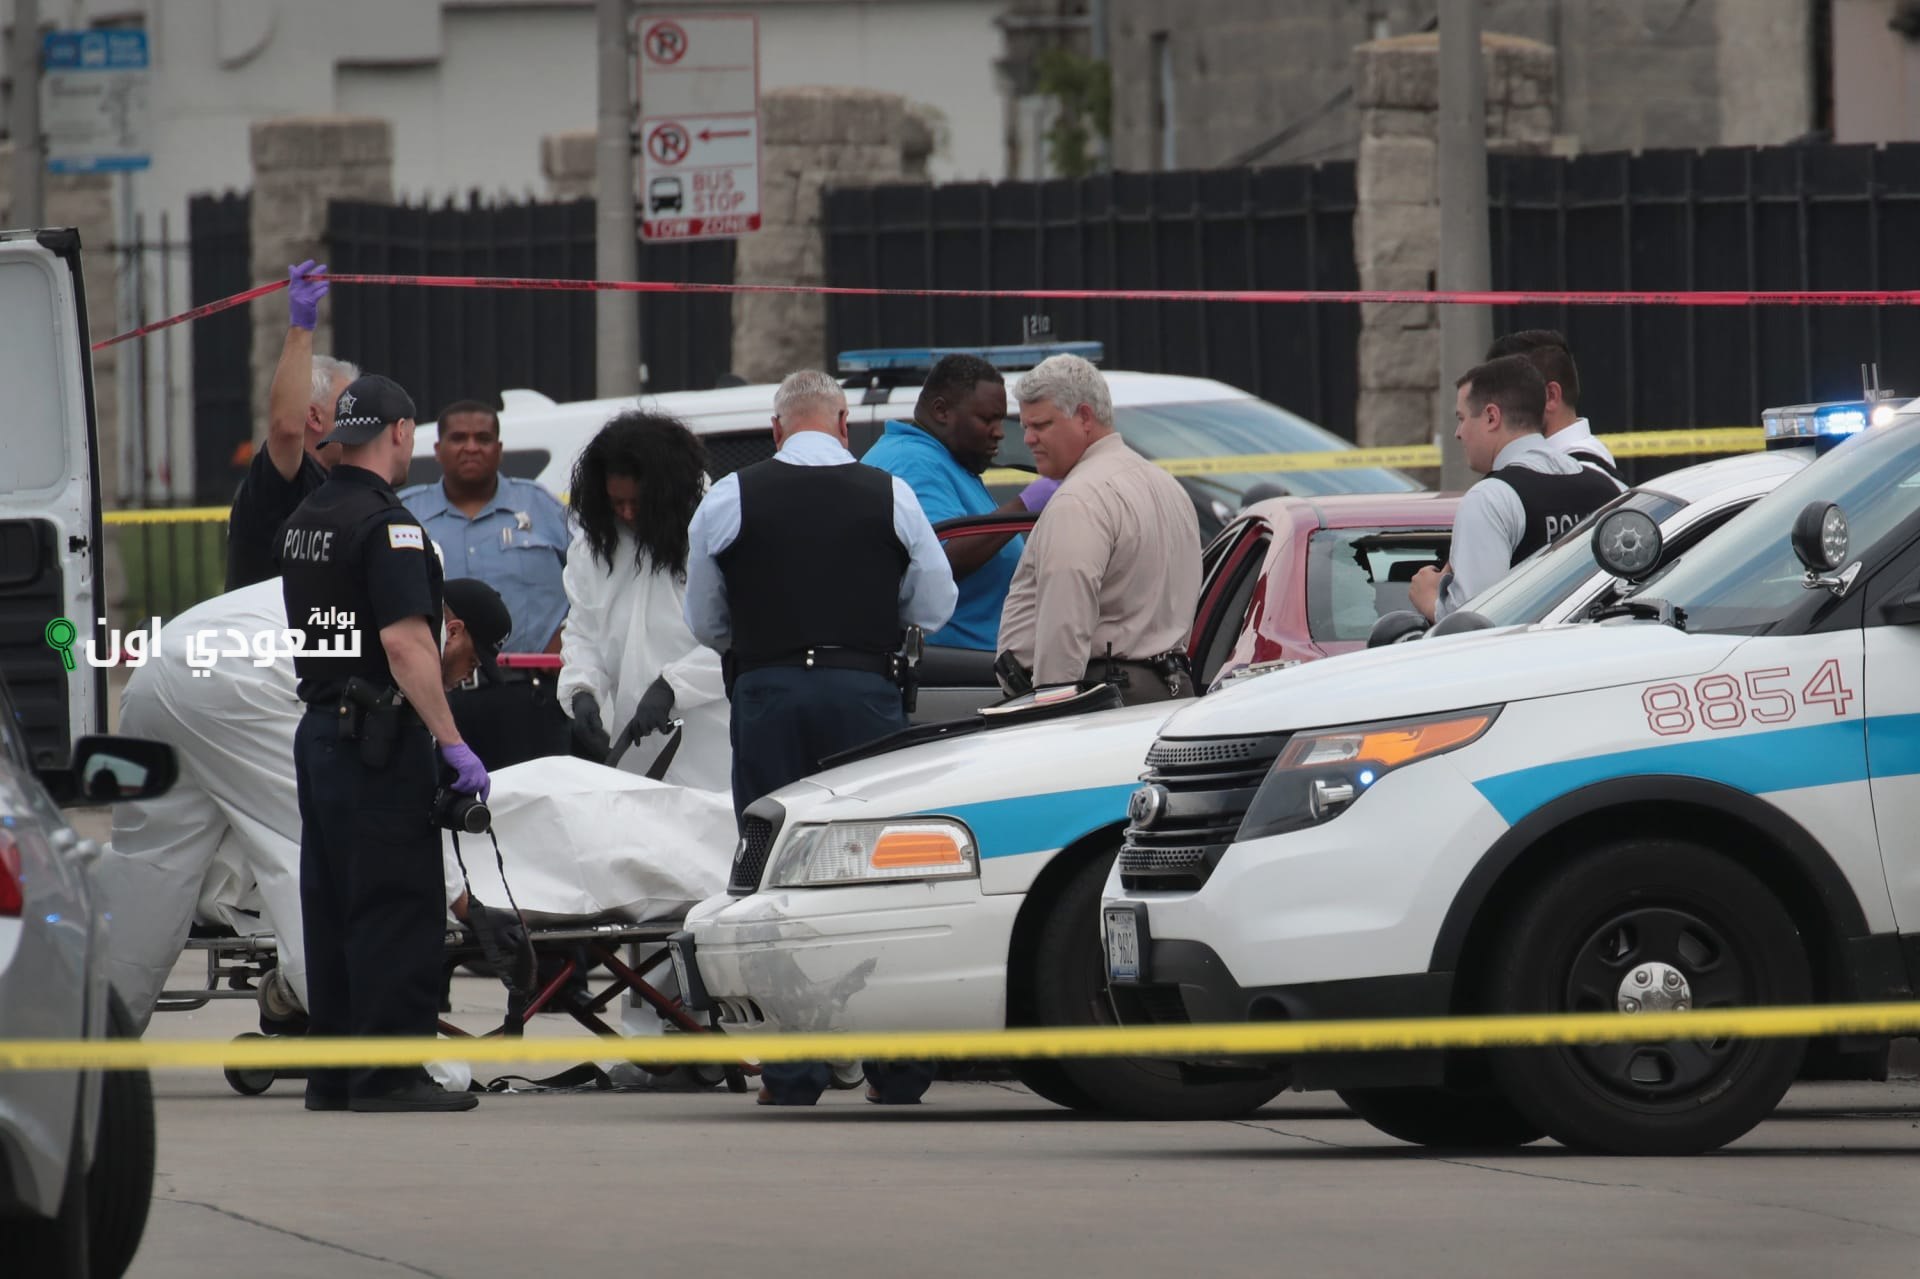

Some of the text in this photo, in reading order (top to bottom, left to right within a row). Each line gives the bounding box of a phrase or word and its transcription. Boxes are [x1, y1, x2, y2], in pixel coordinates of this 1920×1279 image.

[693, 170, 735, 191] BUS
[693, 192, 746, 213] STOP
[283, 528, 334, 562] POLICE
[1641, 658, 1853, 737] 8854
